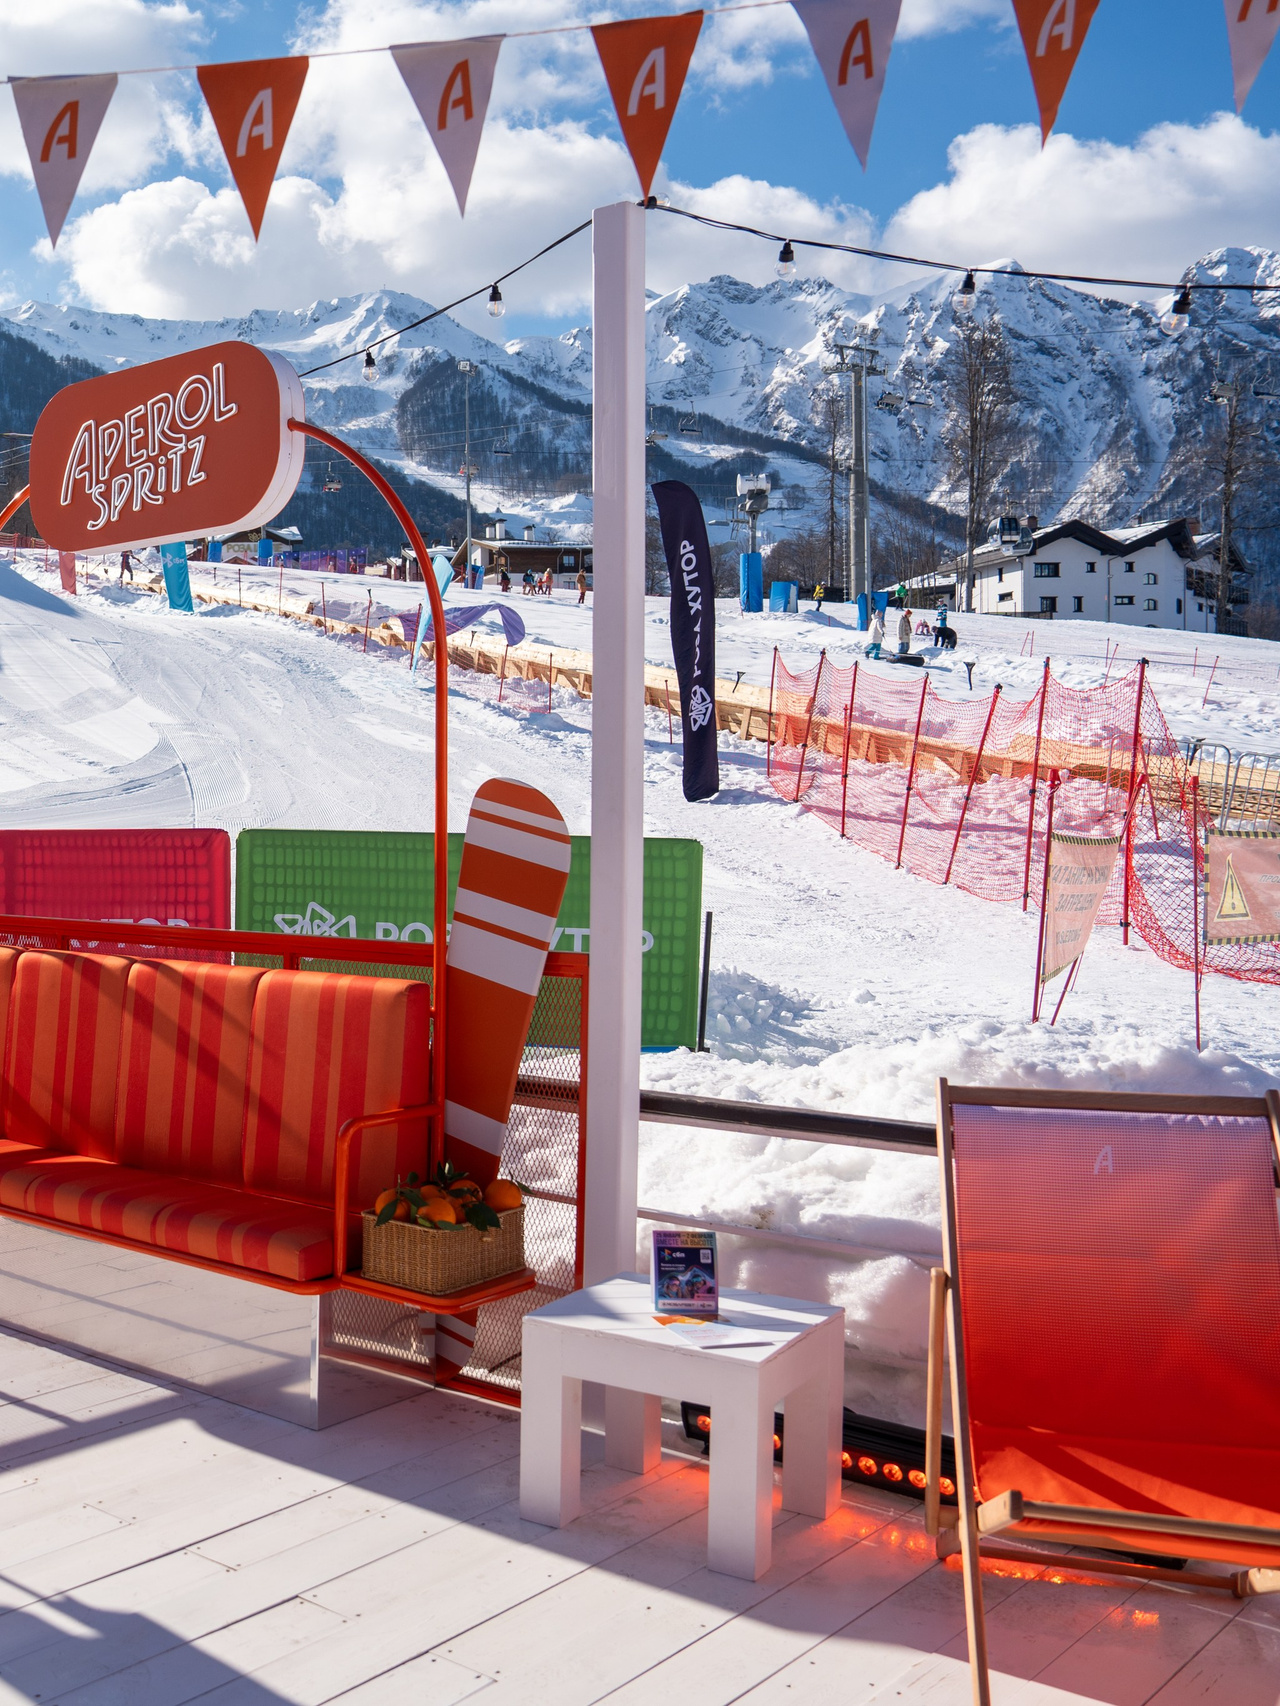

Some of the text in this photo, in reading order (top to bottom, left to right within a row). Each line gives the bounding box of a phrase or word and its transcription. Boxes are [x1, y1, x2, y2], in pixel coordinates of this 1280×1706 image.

[837, 18, 874, 86] A
[1035, 0, 1076, 57] A
[436, 58, 474, 131] A
[626, 46, 666, 116] A
[39, 99, 79, 163] A
[236, 87, 274, 157] A
[60, 362, 238, 506] APEROL
[680, 539, 702, 617] ХУТОР
[1093, 1145, 1114, 1175] A
